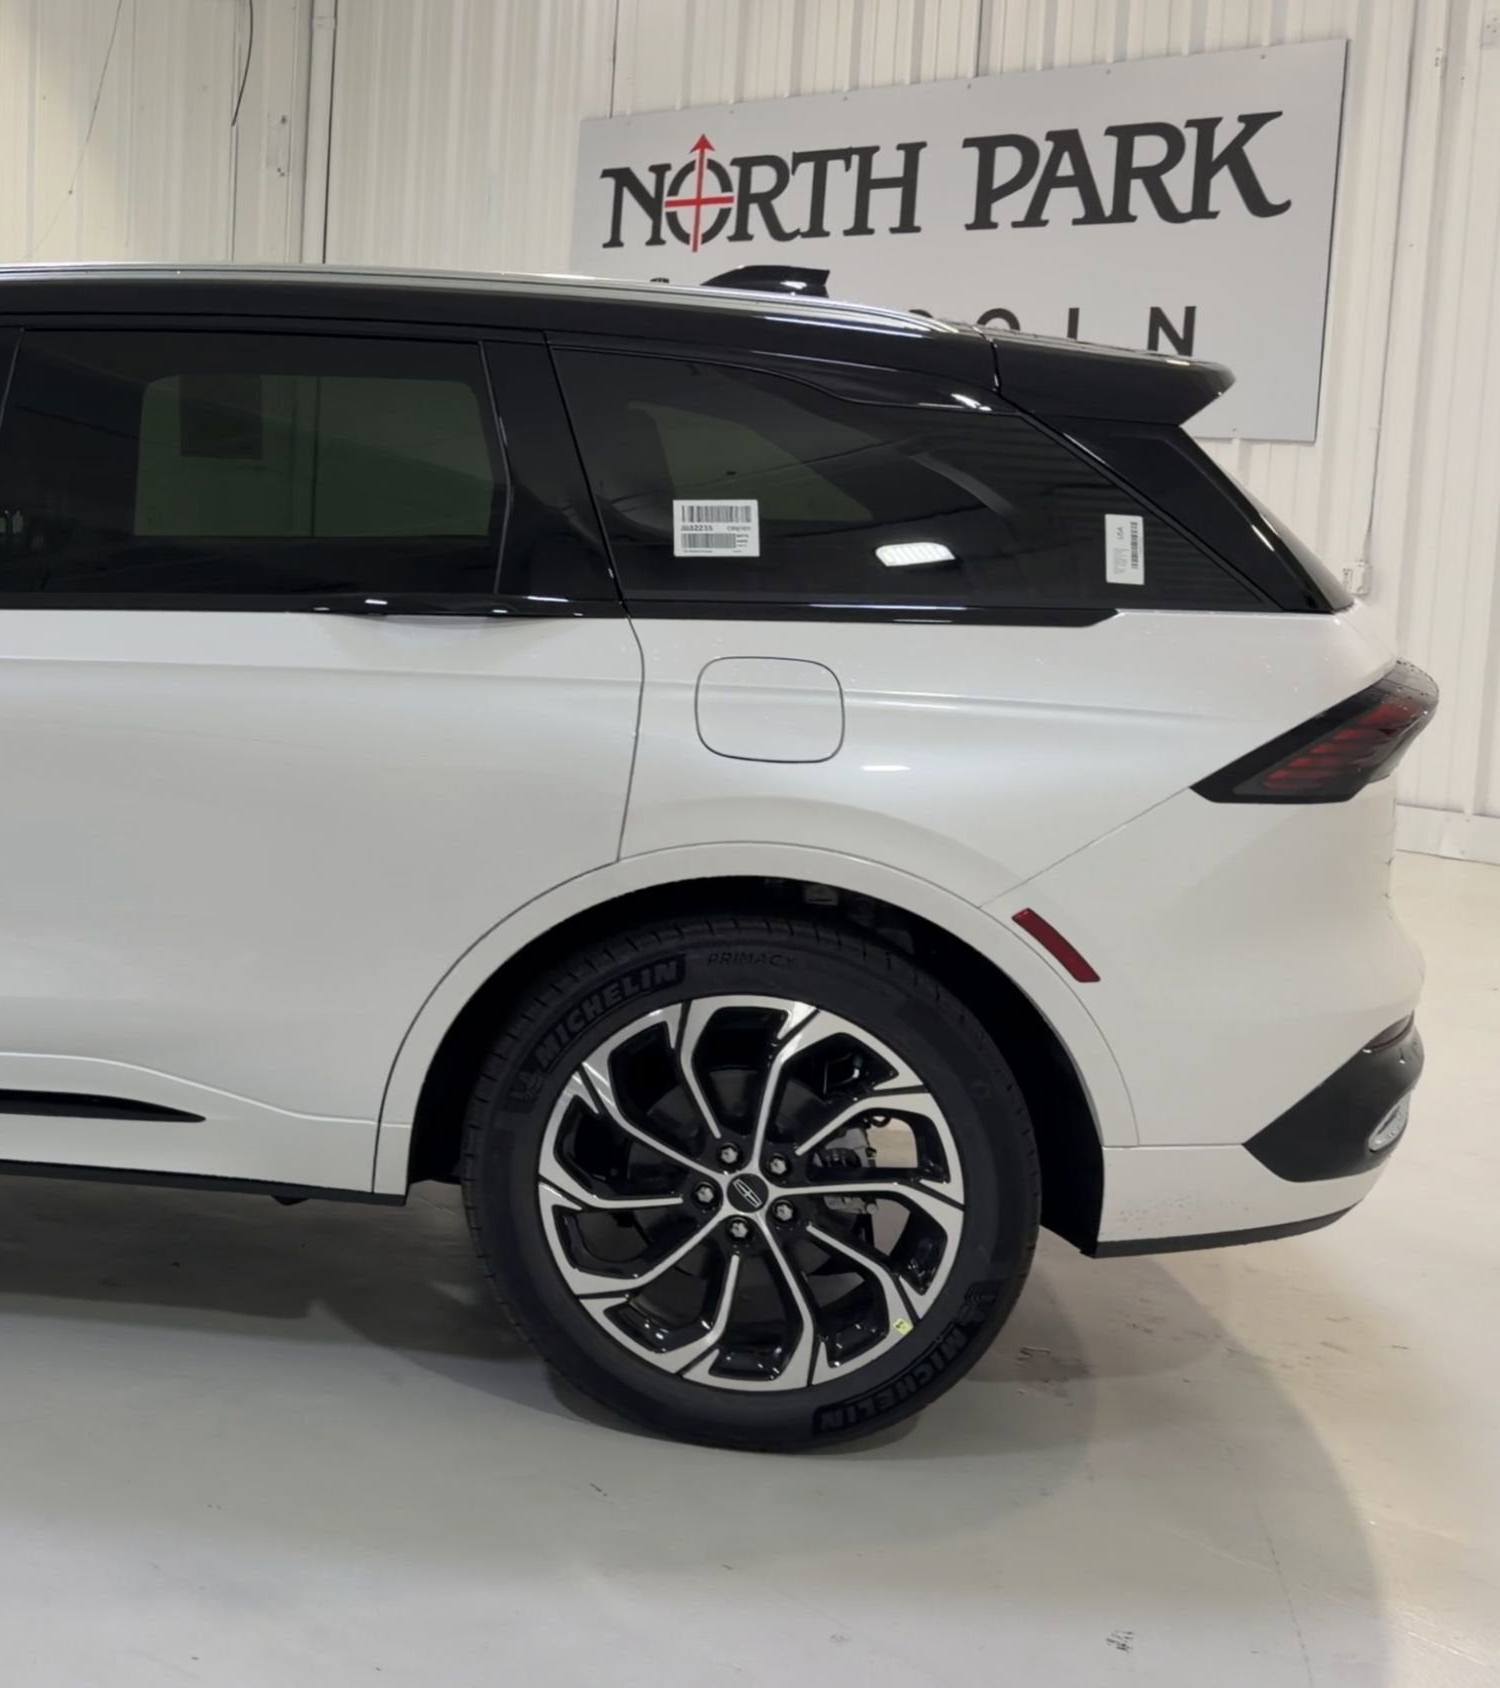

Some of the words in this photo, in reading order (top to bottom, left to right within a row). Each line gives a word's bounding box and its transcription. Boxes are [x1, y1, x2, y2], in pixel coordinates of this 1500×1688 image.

[600, 141, 928, 248] NORTH
[962, 111, 1292, 231] PARK
[707, 951, 796, 968] PRIMACY
[535, 959, 678, 1066] MICHELIN
[820, 1328, 969, 1431] MICHELIN
